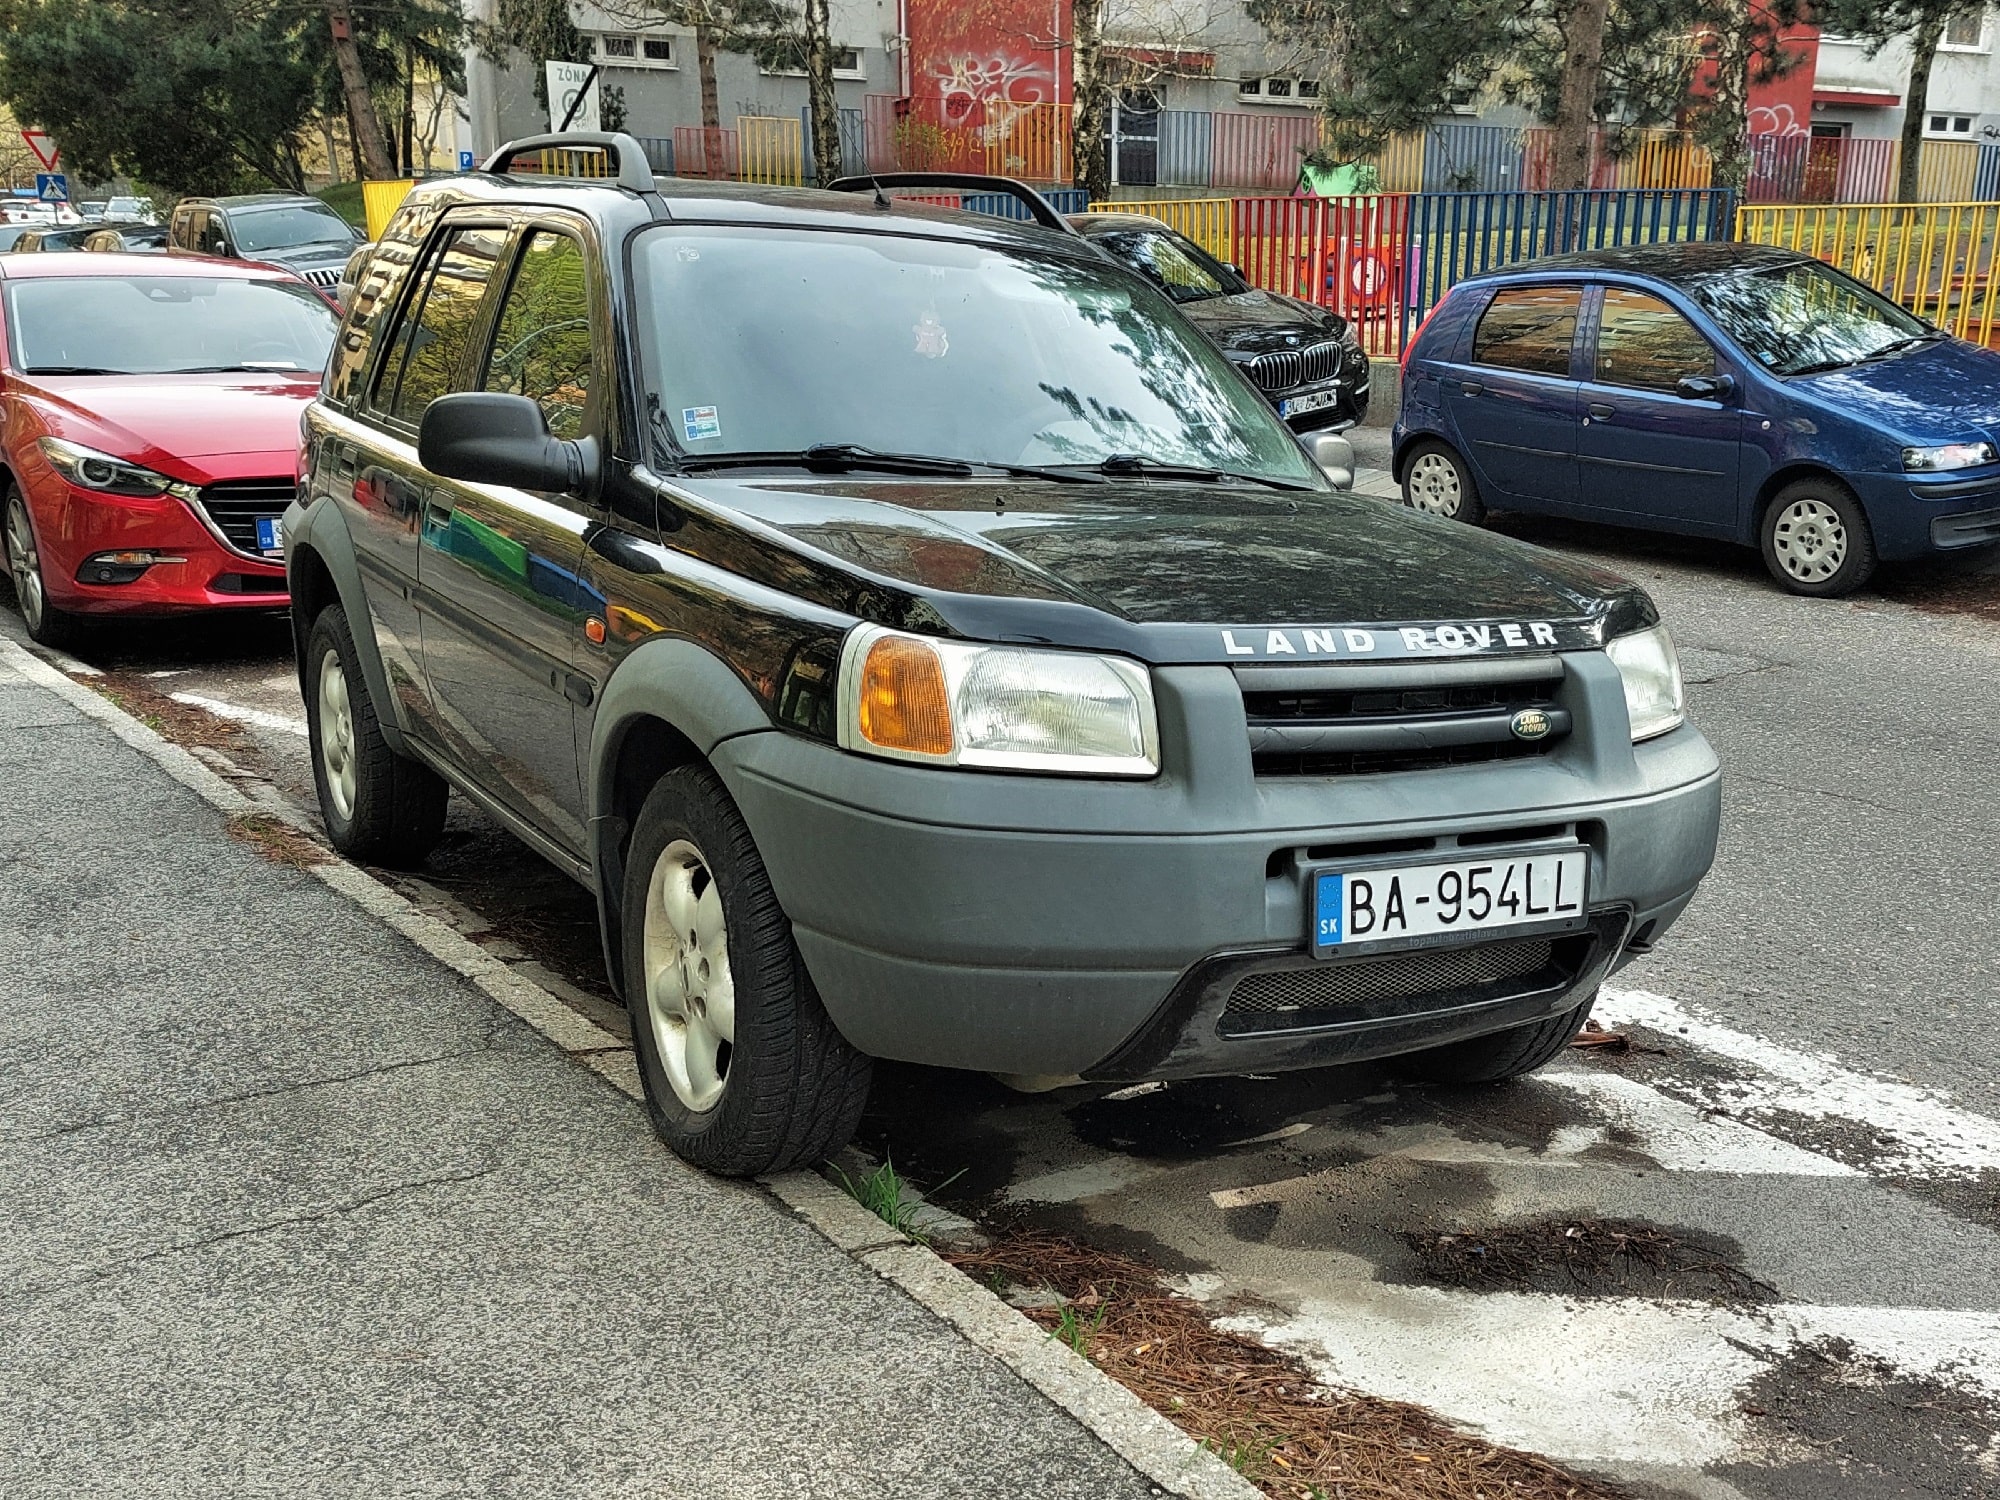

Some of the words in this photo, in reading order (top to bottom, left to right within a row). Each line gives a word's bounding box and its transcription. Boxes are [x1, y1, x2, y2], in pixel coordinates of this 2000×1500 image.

[463, 153, 470, 165] P
[1221, 628, 1376, 655] LAND
[1398, 622, 1558, 651] ROVER
[1520, 715, 1540, 725] LAND
[1523, 723, 1547, 733] ROVER
[1349, 860, 1578, 936] BA-954LL
[1320, 918, 1338, 935] SK
